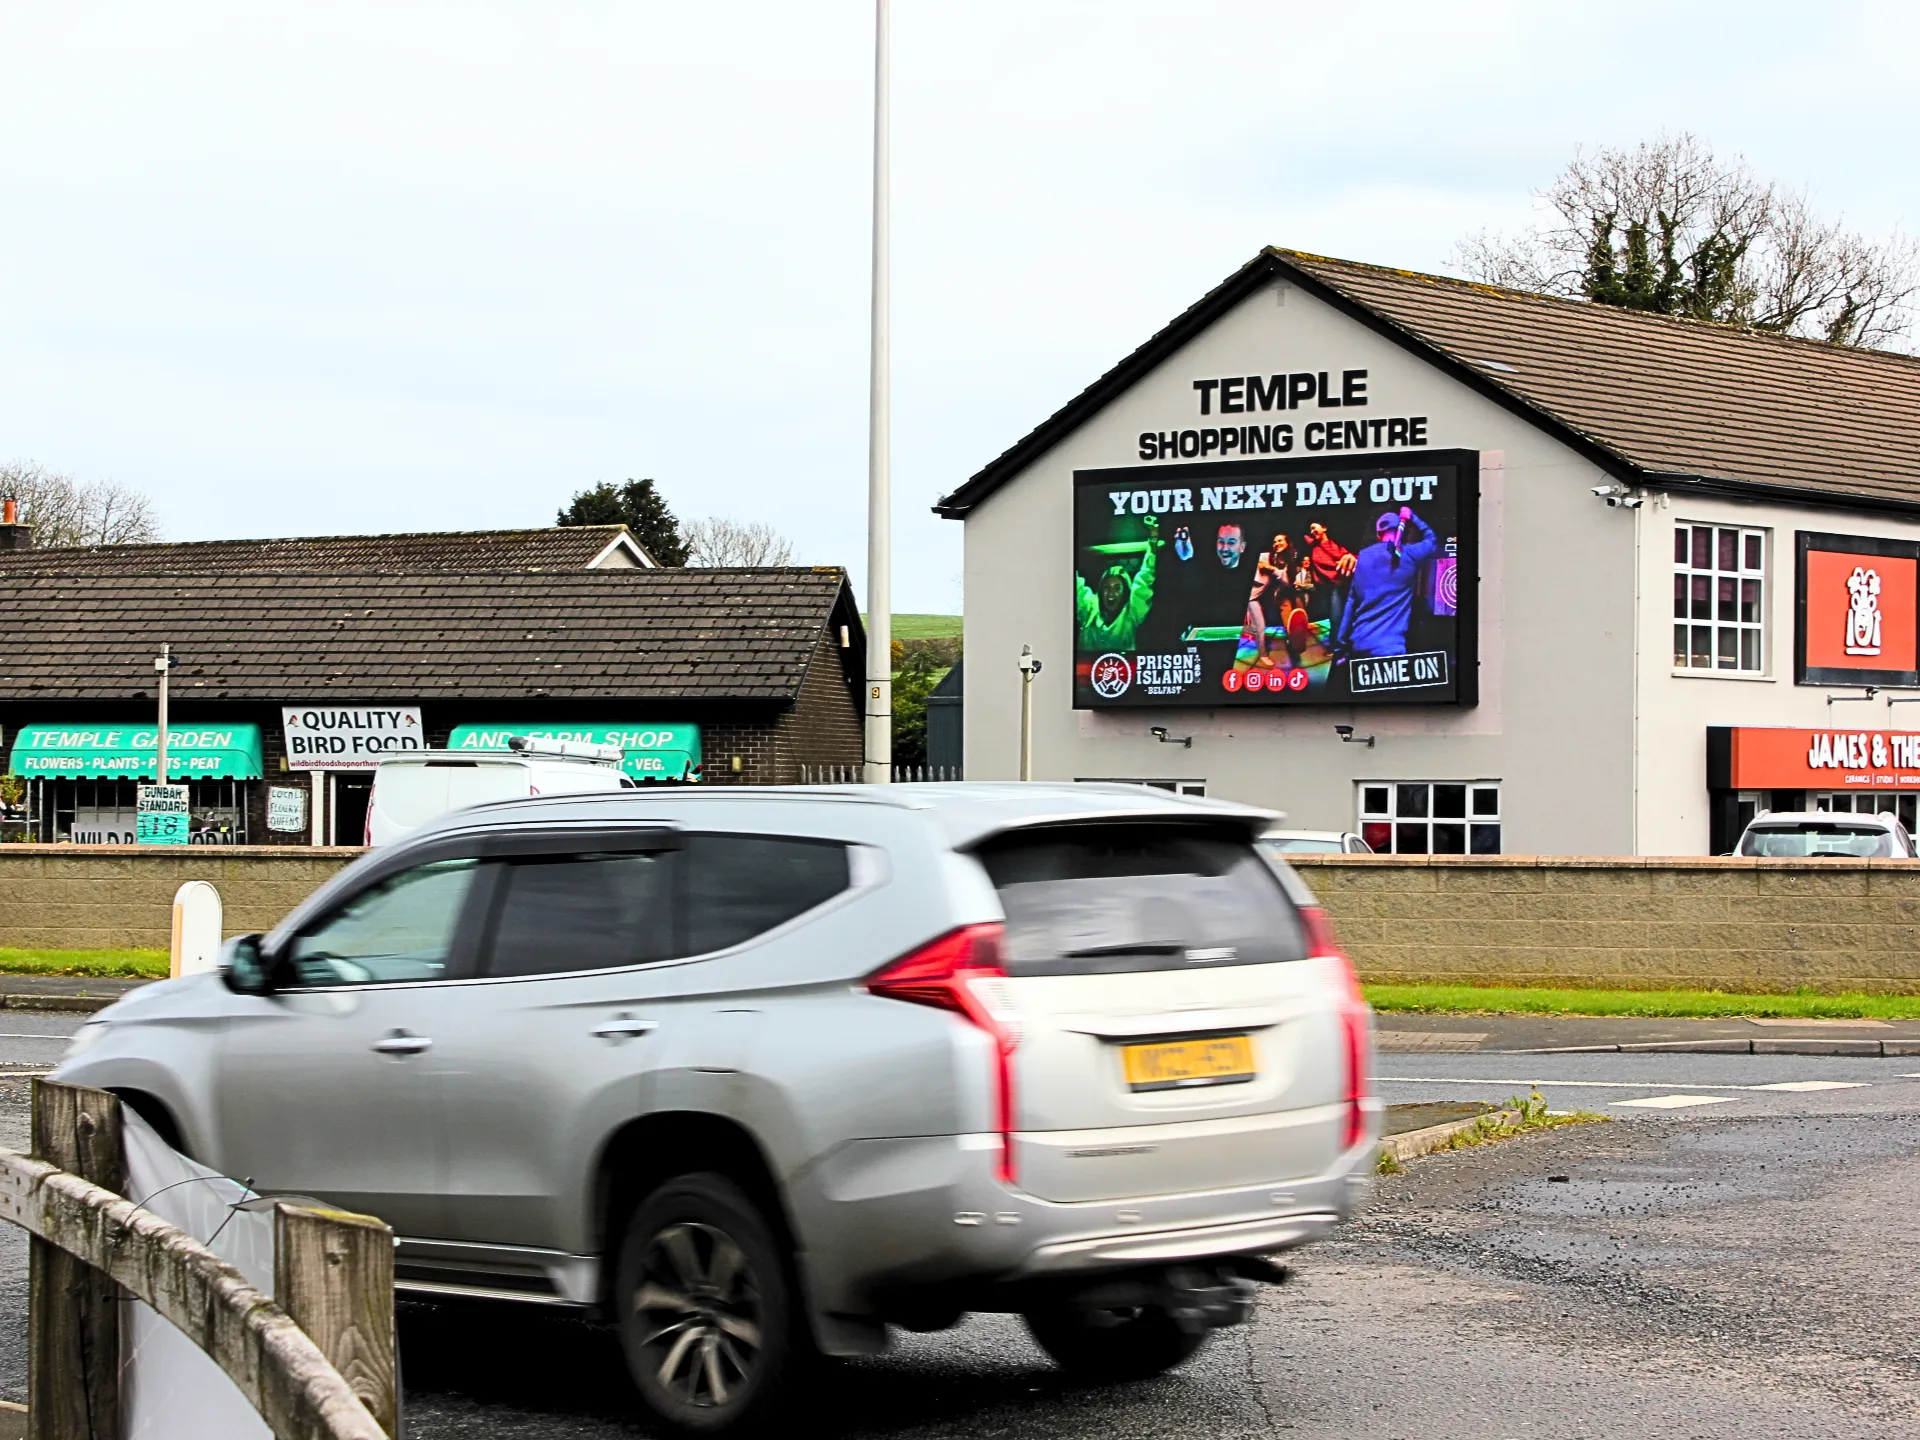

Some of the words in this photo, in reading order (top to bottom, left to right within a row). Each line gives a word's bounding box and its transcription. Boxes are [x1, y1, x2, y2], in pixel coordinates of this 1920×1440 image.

[1193, 369, 1368, 415] TEMPLE
[1138, 424, 1293, 460] SHOPPING
[1304, 416, 1428, 451] CENTRE
[1109, 489, 1193, 515] YOUR
[1200, 483, 1288, 511] NEXT
[1296, 480, 1362, 507] DAY
[1370, 476, 1438, 502] OUT
[1136, 654, 1193, 670] PRISON
[1136, 670, 1194, 685] ISLAND
[1357, 659, 1410, 686] GAME
[1415, 656, 1440, 680] ON
[872, 687, 880, 698] 9
[302, 711, 401, 731] QUALITY
[31, 731, 122, 748] TEMPLE
[291, 736, 346, 754] BIRD
[352, 736, 418, 754] FOOD
[461, 731, 513, 748] AND
[602, 731, 674, 748] SHOP
[1808, 733, 1868, 768] JAMES
[1872, 734, 1888, 768] &
[25, 757, 84, 769] FLOWERS
[92, 757, 140, 770] PLANTS
[148, 757, 181, 769] PTS
[189, 757, 222, 770] PEAT
[635, 758, 665, 771] VEG.
[145, 786, 182, 799] DUNBAR
[139, 800, 187, 812] STANDARD
